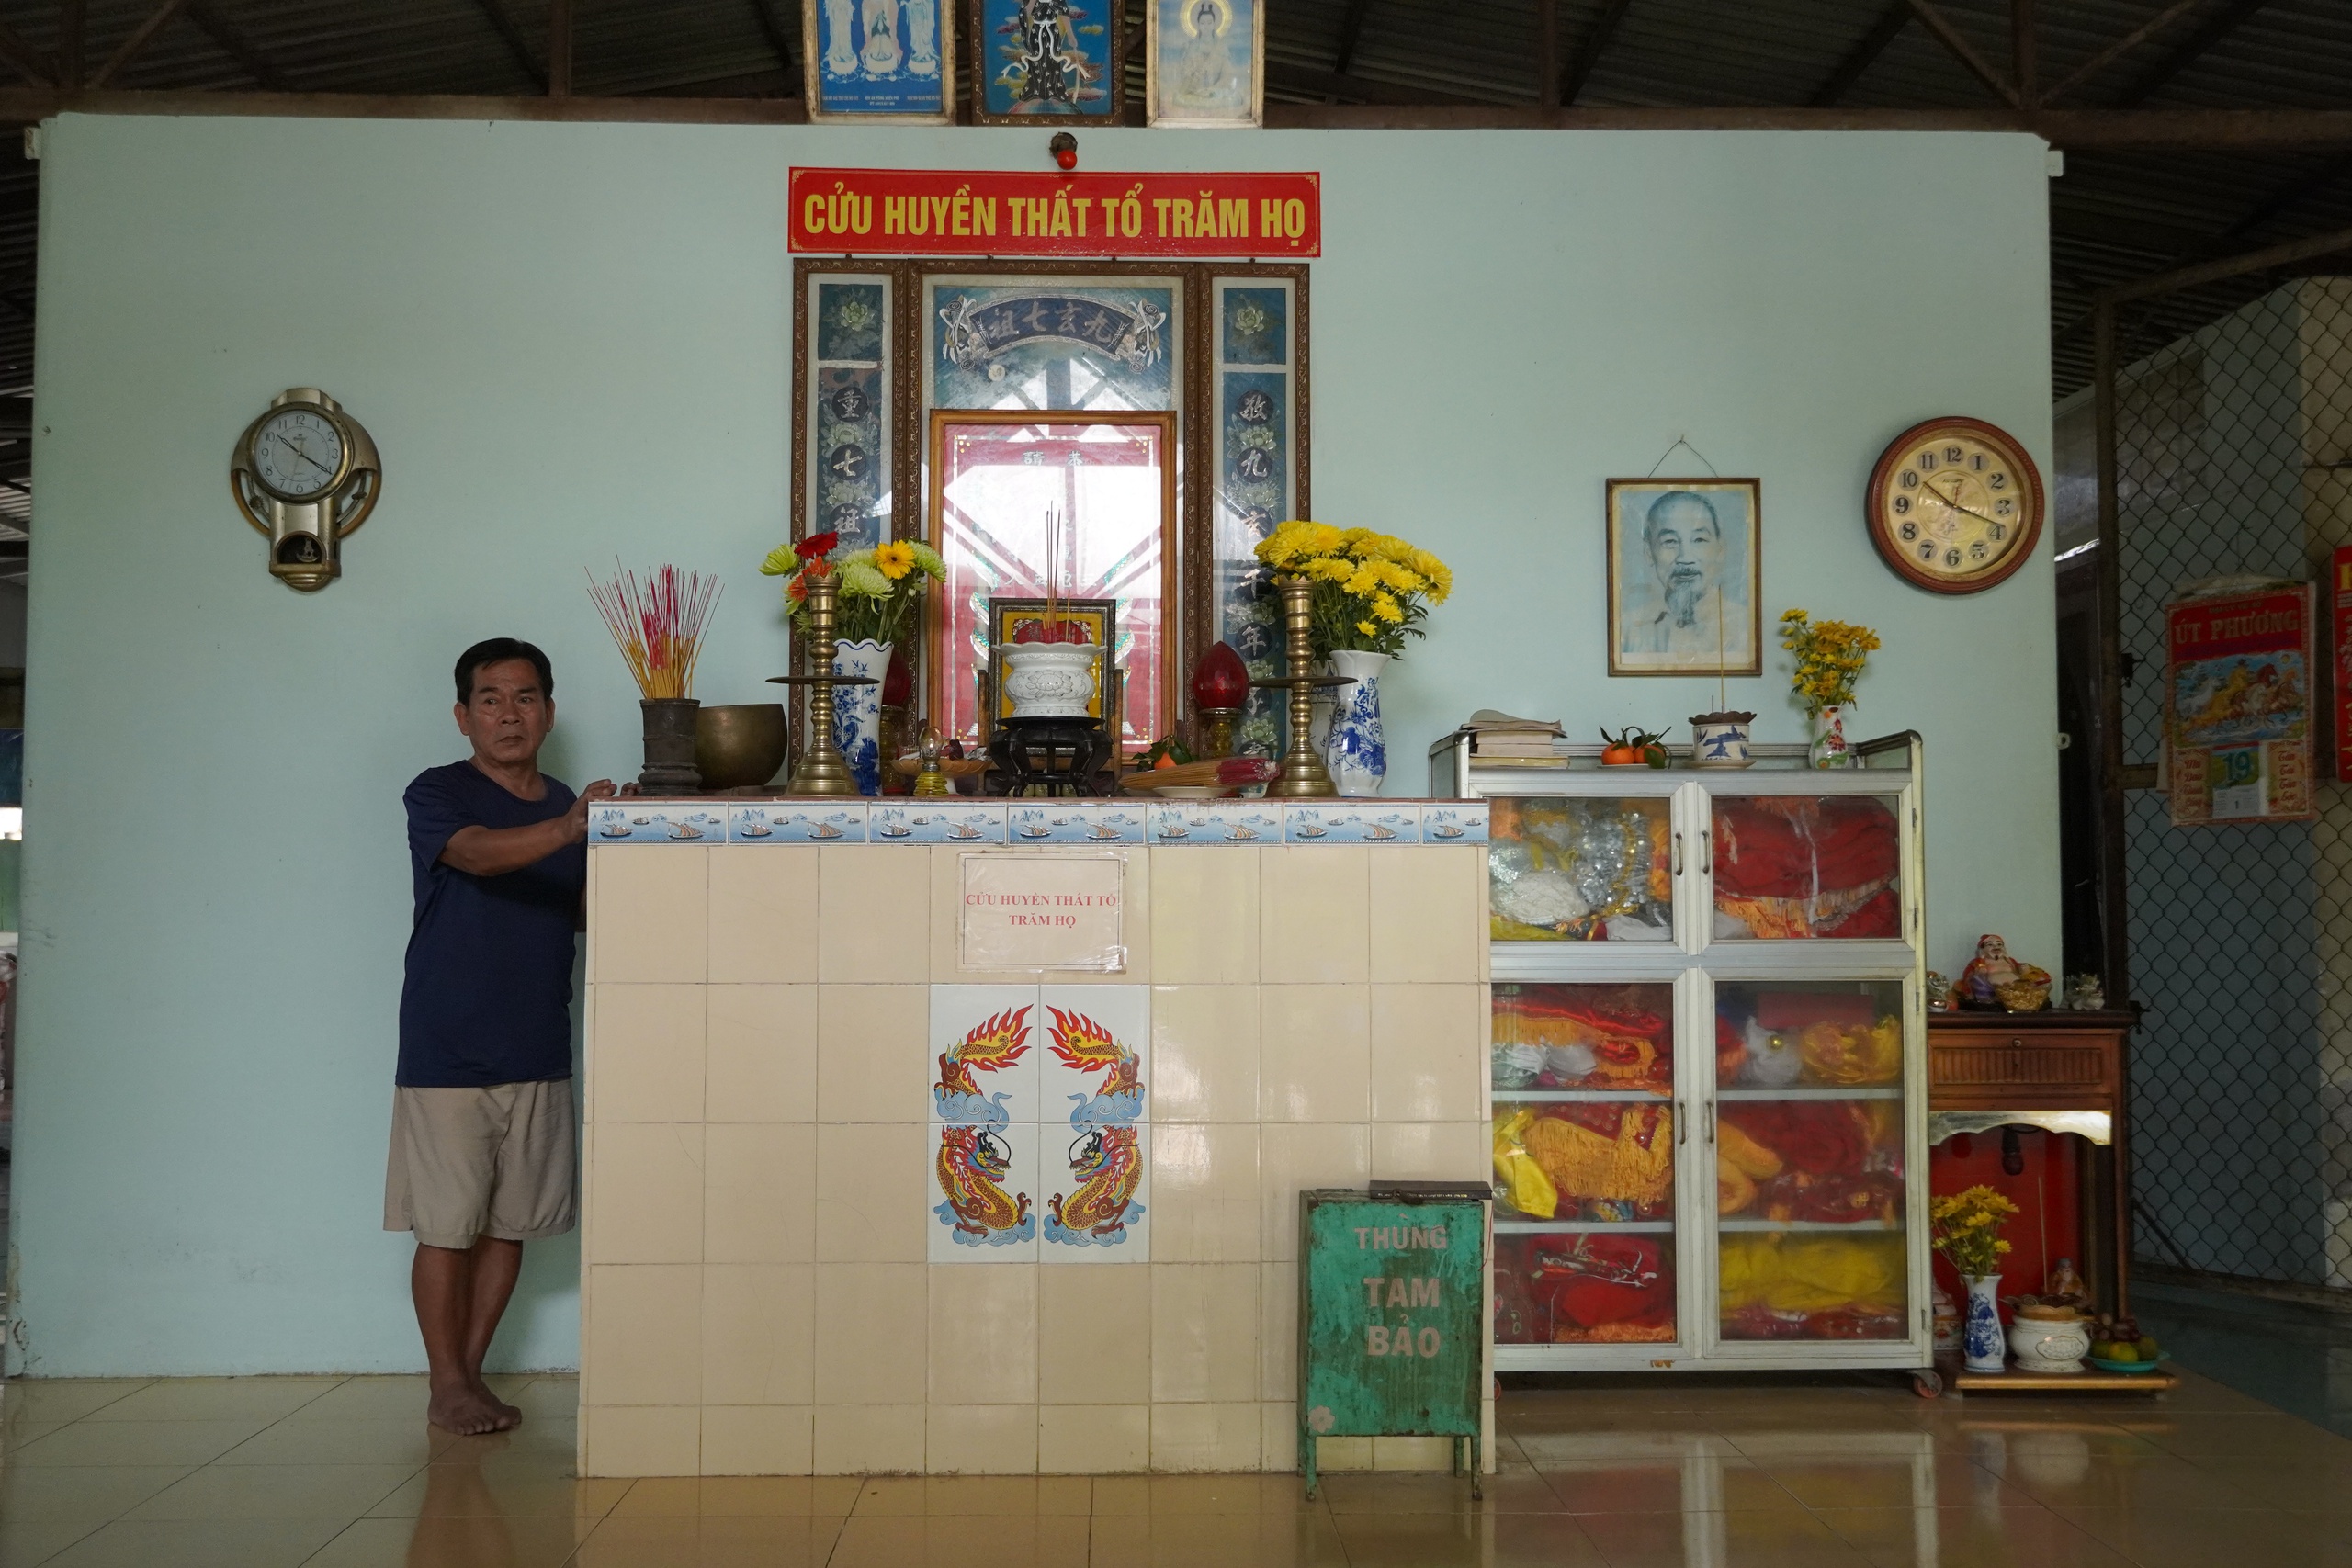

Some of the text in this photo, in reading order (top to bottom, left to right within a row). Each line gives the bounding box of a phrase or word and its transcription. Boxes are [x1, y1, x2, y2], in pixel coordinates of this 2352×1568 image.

[804, 181, 1306, 247] CỬU HUYỀN THẤT TỔ TRĂM HỌ
[296, 415, 305, 425] 12
[327, 431, 334, 442] 2
[261, 448, 268, 458] 9
[332, 448, 339, 459] 3
[1946, 446, 1962, 463] 12
[1921, 454, 1934, 469] 11
[1975, 455, 1982, 470] 1
[266, 466, 273, 476] 8
[313, 479, 322, 489] 5
[1902, 472, 1917, 488] 10
[1991, 473, 2004, 490] 2
[296, 483, 304, 493] 6
[1895, 497, 1909, 513] 9
[1997, 500, 2011, 515] 3
[1902, 523, 1916, 539] 8
[1989, 525, 2003, 540] 4
[1921, 544, 1934, 558] 7
[1947, 550, 1960, 566] 6
[1972, 544, 1984, 559] 5
[2174, 618, 2202, 645] ÚT
[2222, 751, 2250, 781] 19
[966, 892, 996, 906] CỬU
[1001, 893, 1050, 906] HUYỀN
[1054, 892, 1093, 907] THẤT
[1009, 912, 1076, 929] TRĂM HỌ
[1353, 1213, 1449, 1250] THÙNG
[1363, 1278, 1441, 1309] TAM
[1366, 1314, 1442, 1359] BẢO
